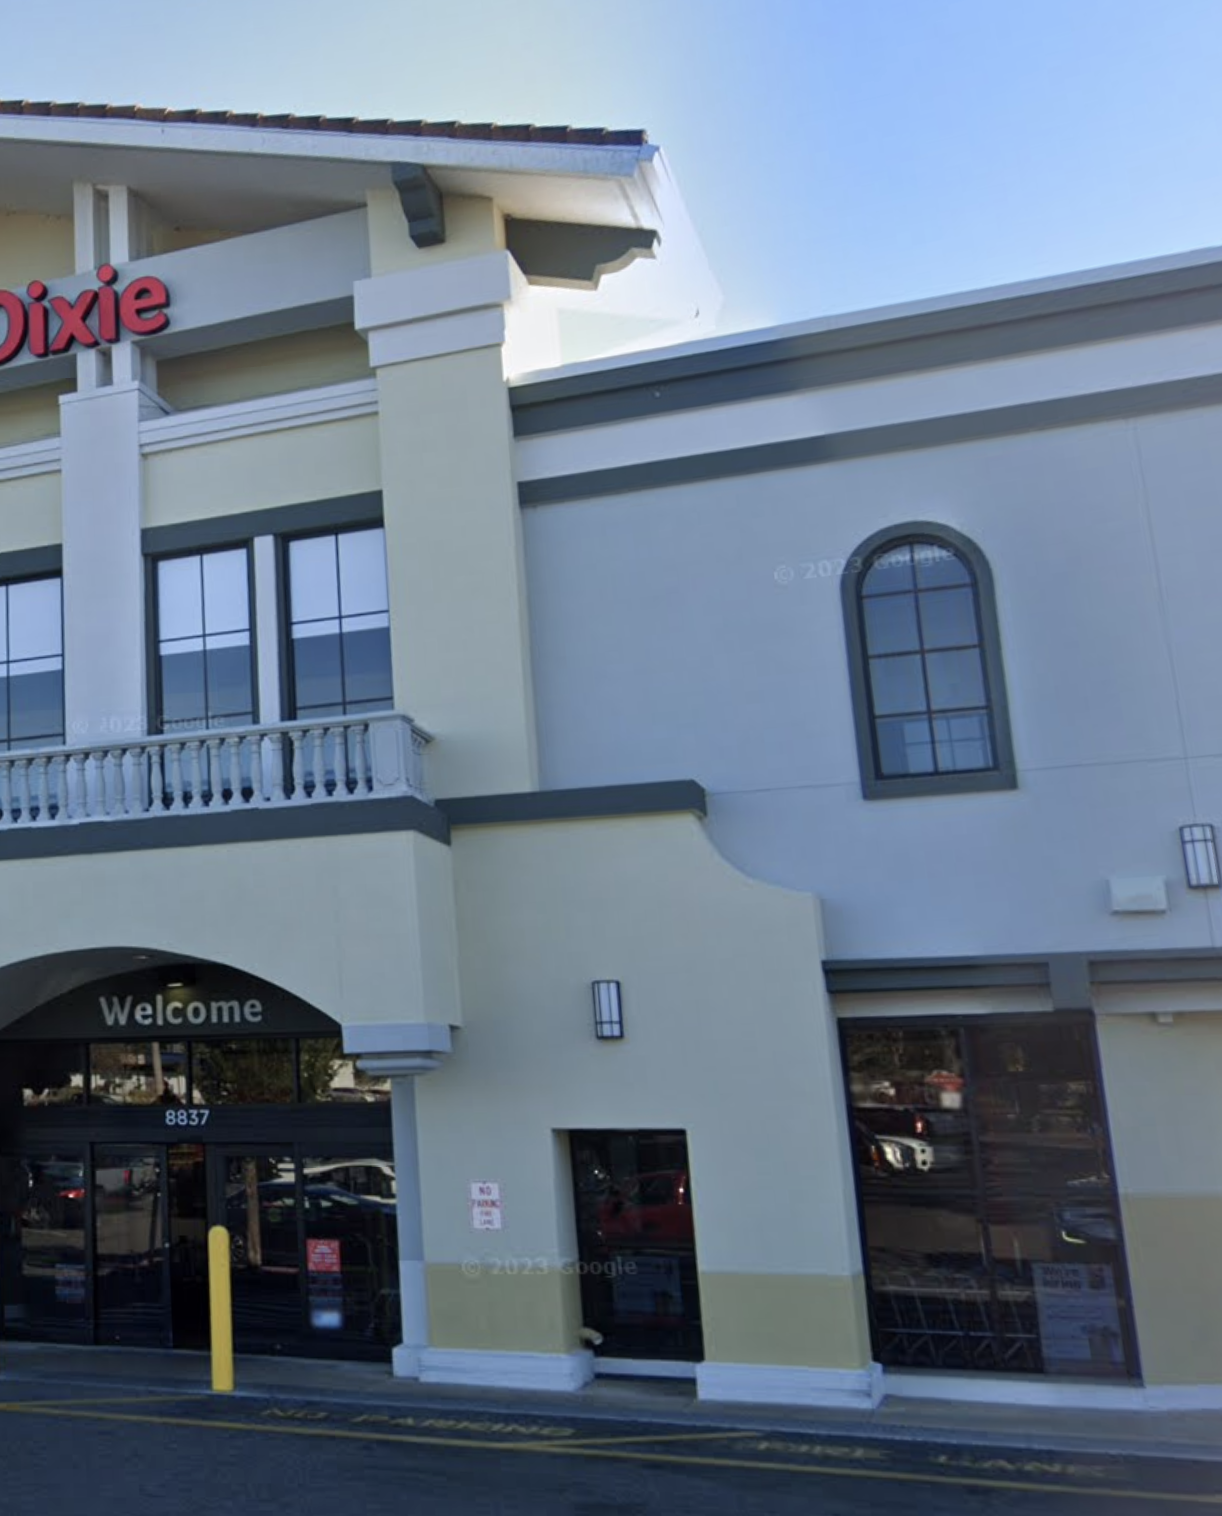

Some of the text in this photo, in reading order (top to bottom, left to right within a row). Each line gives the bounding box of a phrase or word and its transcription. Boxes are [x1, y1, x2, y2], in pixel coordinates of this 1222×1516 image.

[99, 994, 263, 1026] Welcome
[165, 1109, 210, 1126] 8837
[479, 1185, 492, 1196] NO
[471, 1199, 502, 1208] PARKING
[260, 1405, 577, 1438] NO PARKING
